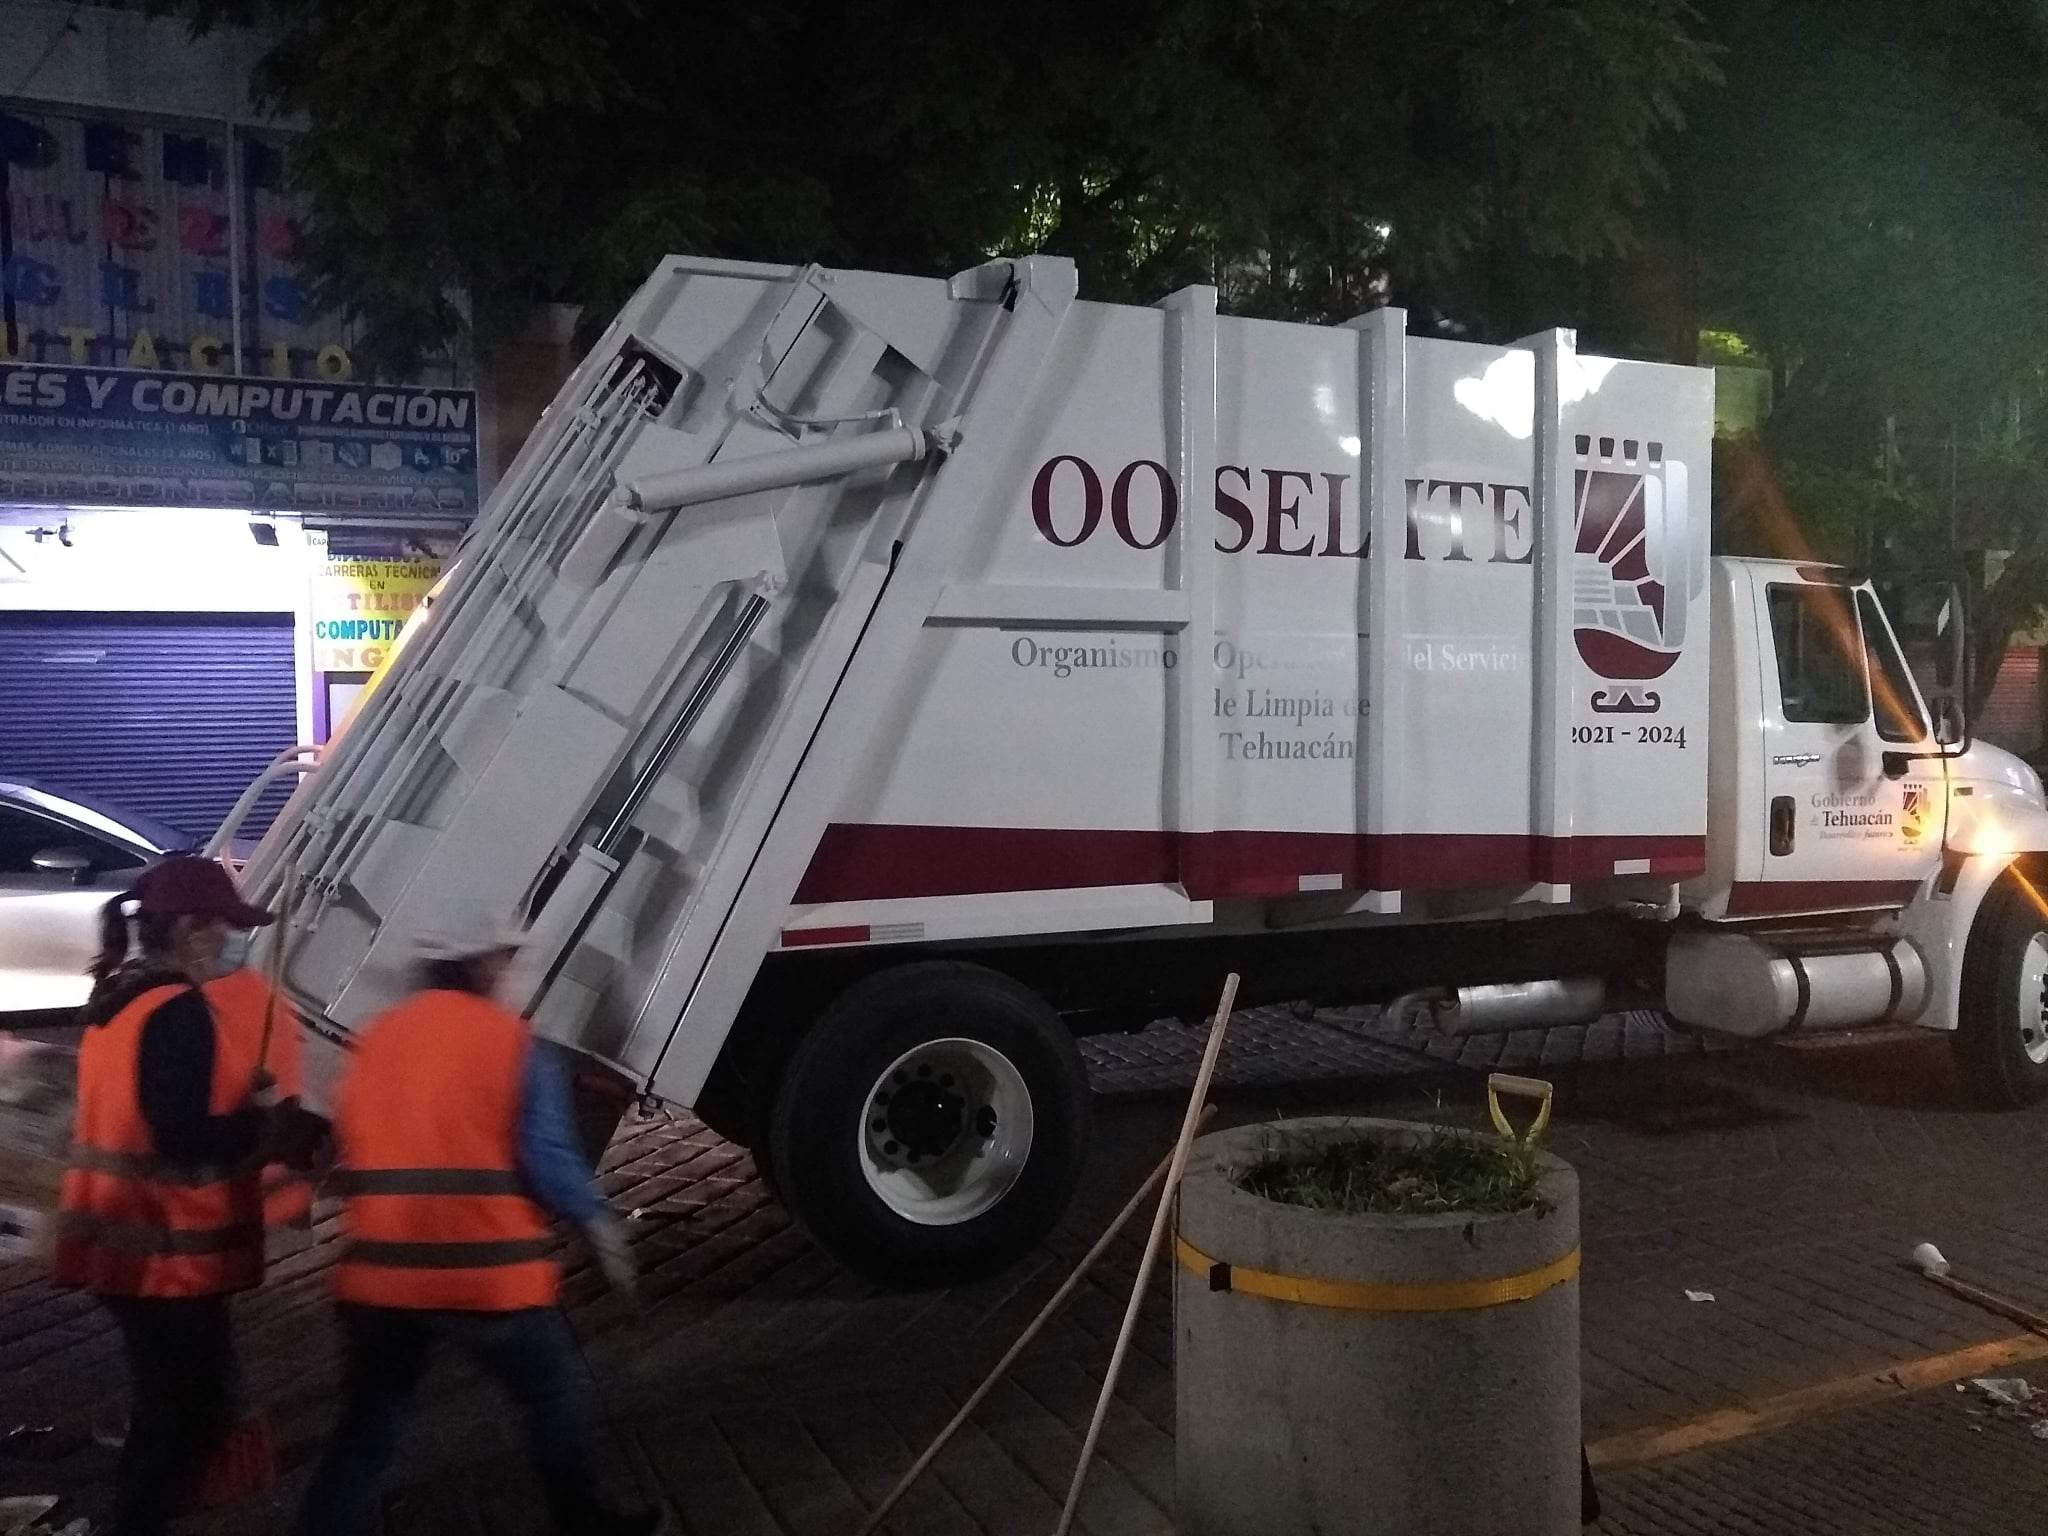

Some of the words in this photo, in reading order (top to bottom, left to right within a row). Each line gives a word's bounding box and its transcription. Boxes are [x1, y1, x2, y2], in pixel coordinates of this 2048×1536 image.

[0, 366, 68, 408] ÉS
[85, 375, 119, 409] Y
[132, 379, 469, 428] COMPUTACIÓN
[0, 414, 55, 428] TRADOR
[369, 580, 385, 590] EN
[1011, 636, 1178, 679] Organismo
[1441, 643, 1518, 672] Servici
[1218, 728, 1354, 761] Tehuacán
[1638, 726, 1687, 749] 2024
[1811, 792, 1877, 808] Gobierno
[1822, 809, 1894, 827] Tehuacán
